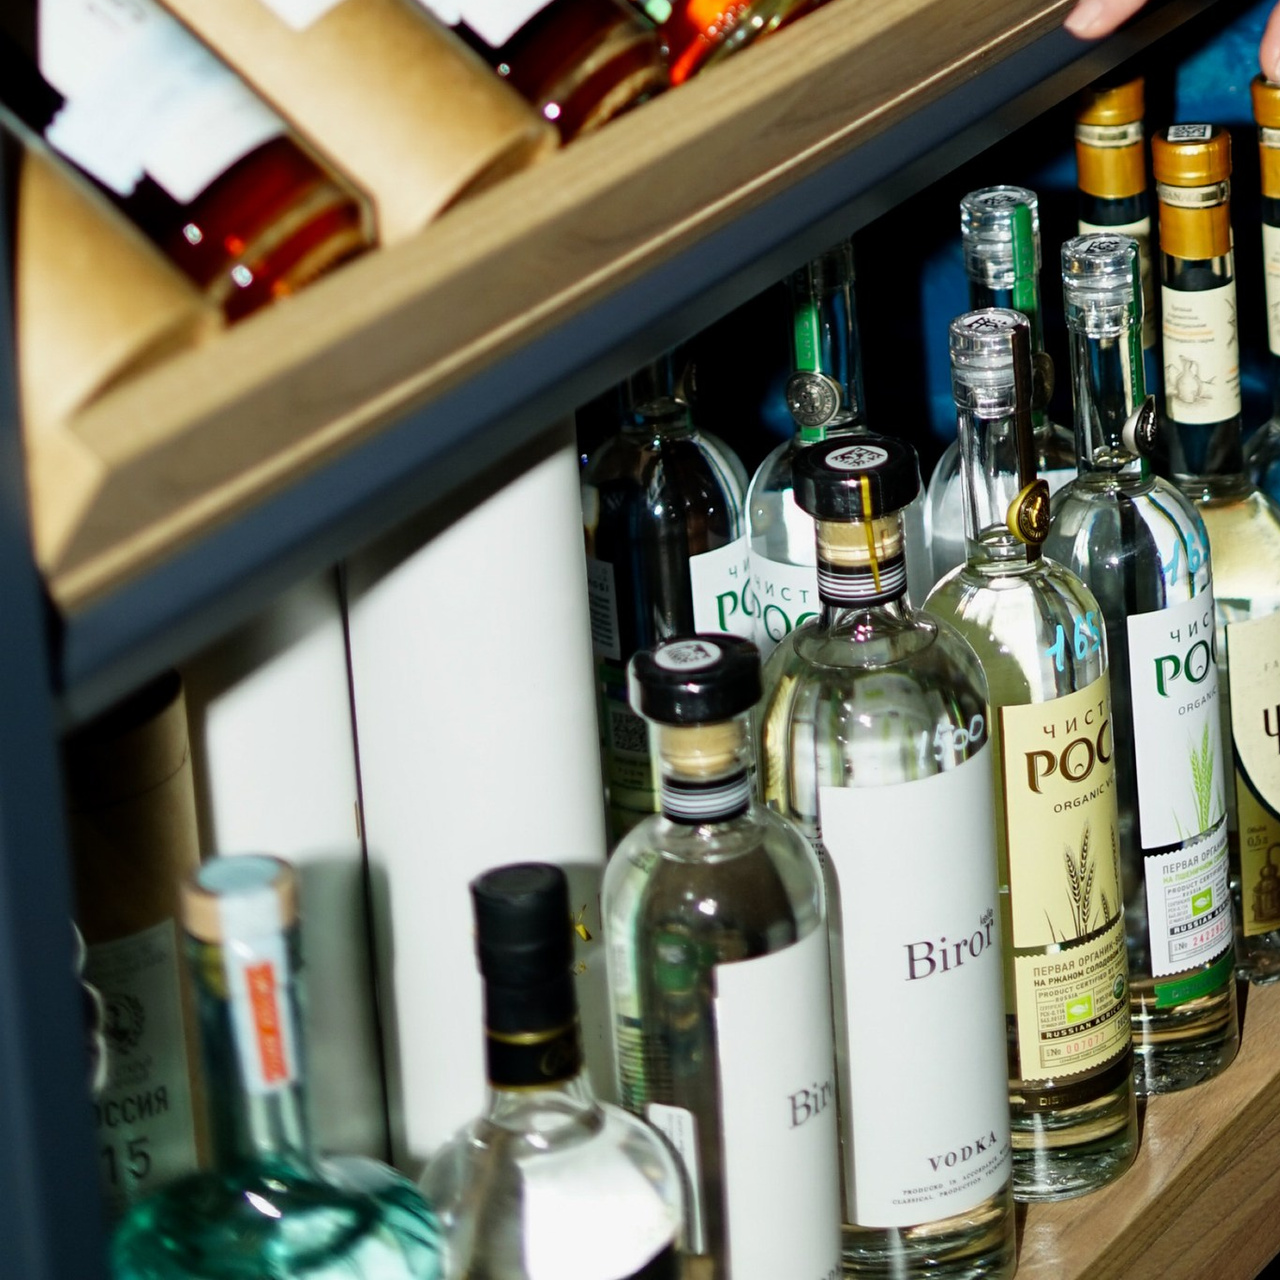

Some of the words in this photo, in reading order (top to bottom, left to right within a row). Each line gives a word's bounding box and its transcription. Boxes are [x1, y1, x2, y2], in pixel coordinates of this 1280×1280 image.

[1053, 787, 1105, 814] ORGANIC
[1162, 855, 1200, 876] ПЕРВАЯ
[1174, 913, 1213, 934] RUSSIAN
[1033, 960, 1075, 977] ПЕРВАЯ
[1034, 979, 1046, 988] НА
[1048, 970, 1084, 986] РЖАНОМ
[1038, 986, 1074, 999] PRODUCT
[1075, 972, 1107, 990] CERTIFIED
[1045, 1021, 1092, 1040] RUSSIAN
[928, 1130, 998, 1173] VODKA
